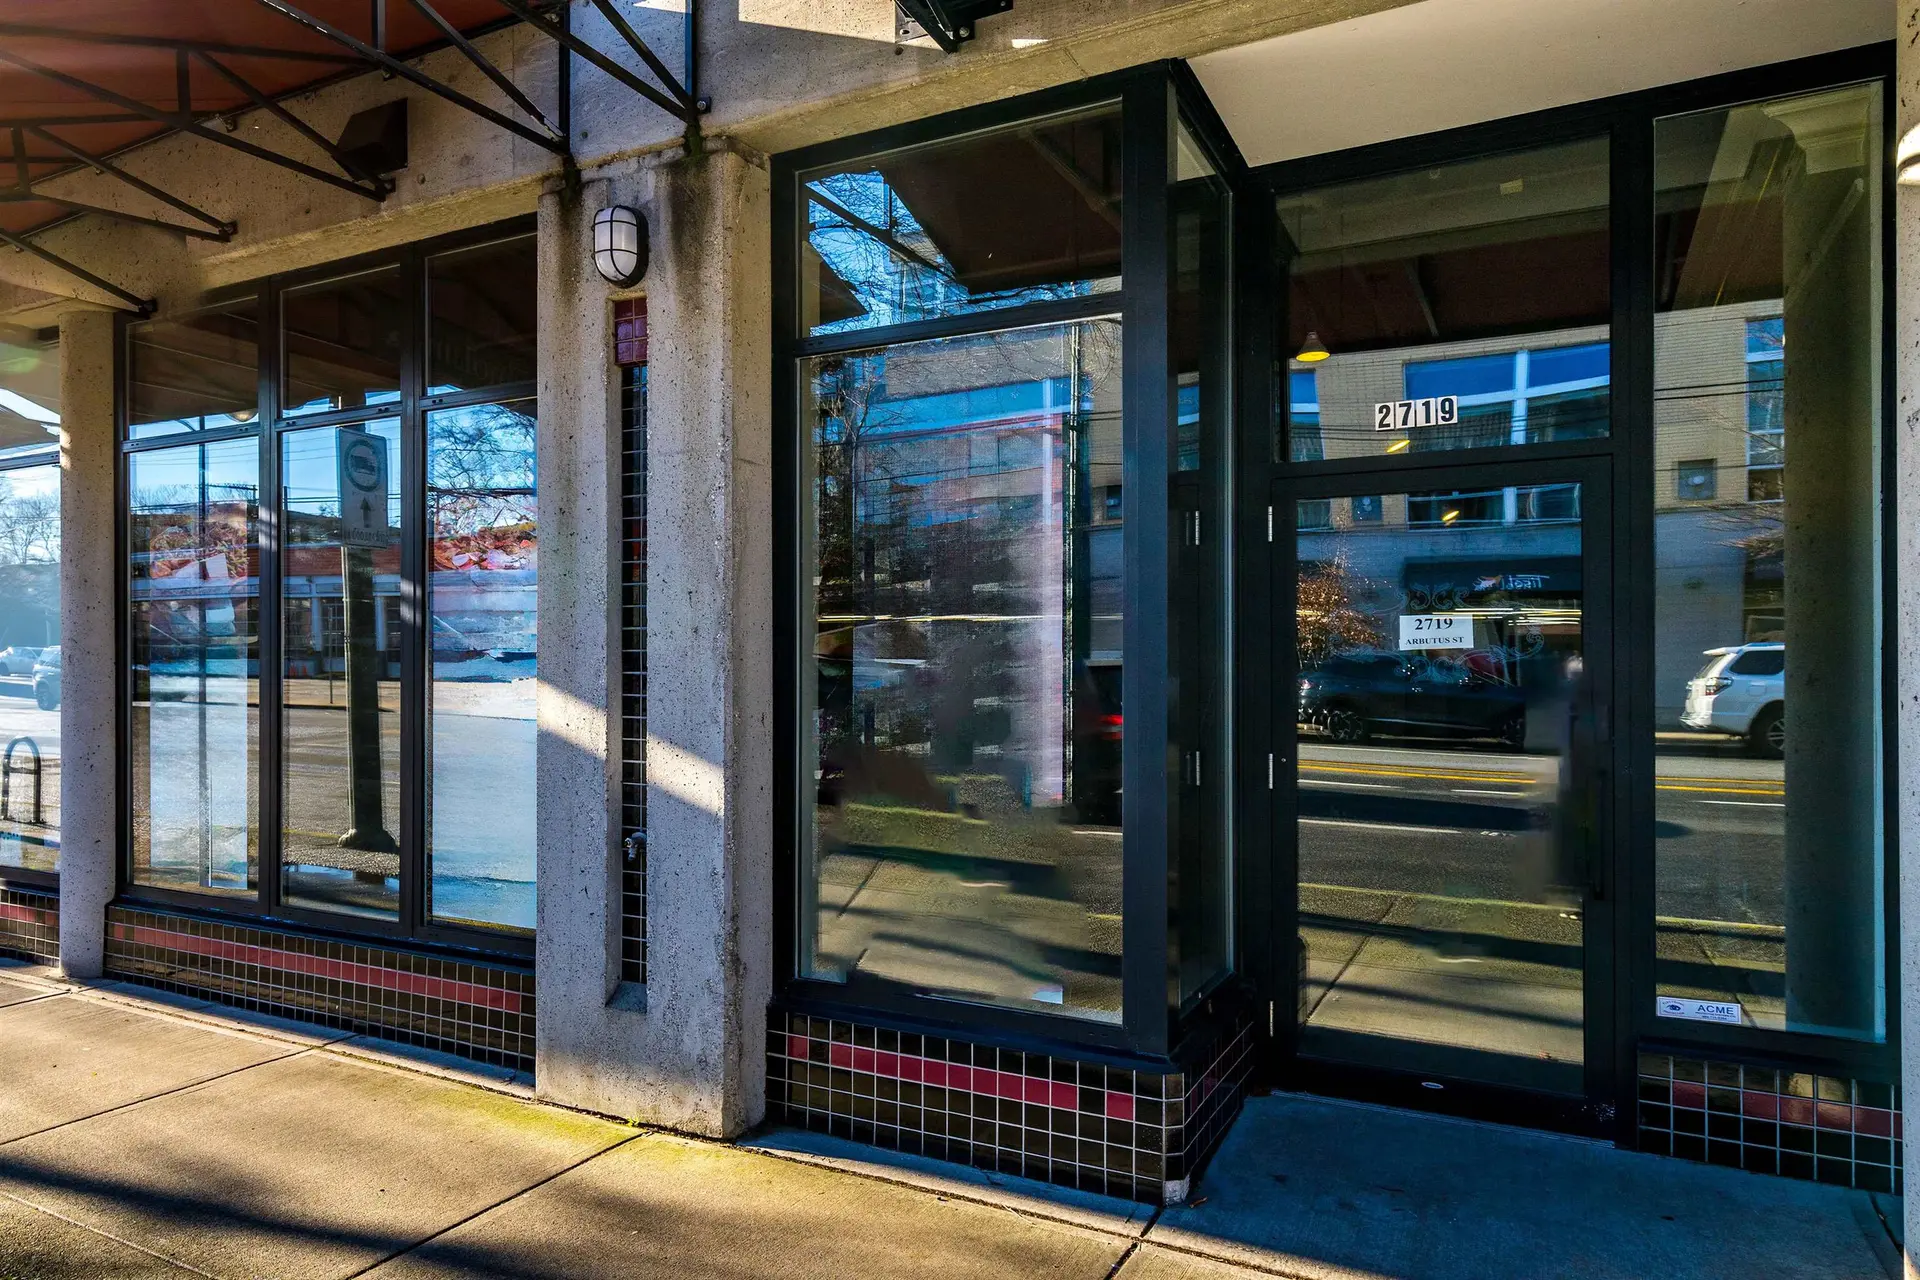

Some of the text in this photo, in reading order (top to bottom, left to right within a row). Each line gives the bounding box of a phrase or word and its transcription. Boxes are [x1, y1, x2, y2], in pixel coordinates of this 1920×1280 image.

[1378, 397, 1454, 428] 2719
[1414, 618, 1453, 630] 2719
[1405, 637, 1450, 645] ARBUTUS
[1697, 1005, 1734, 1015] ACME
